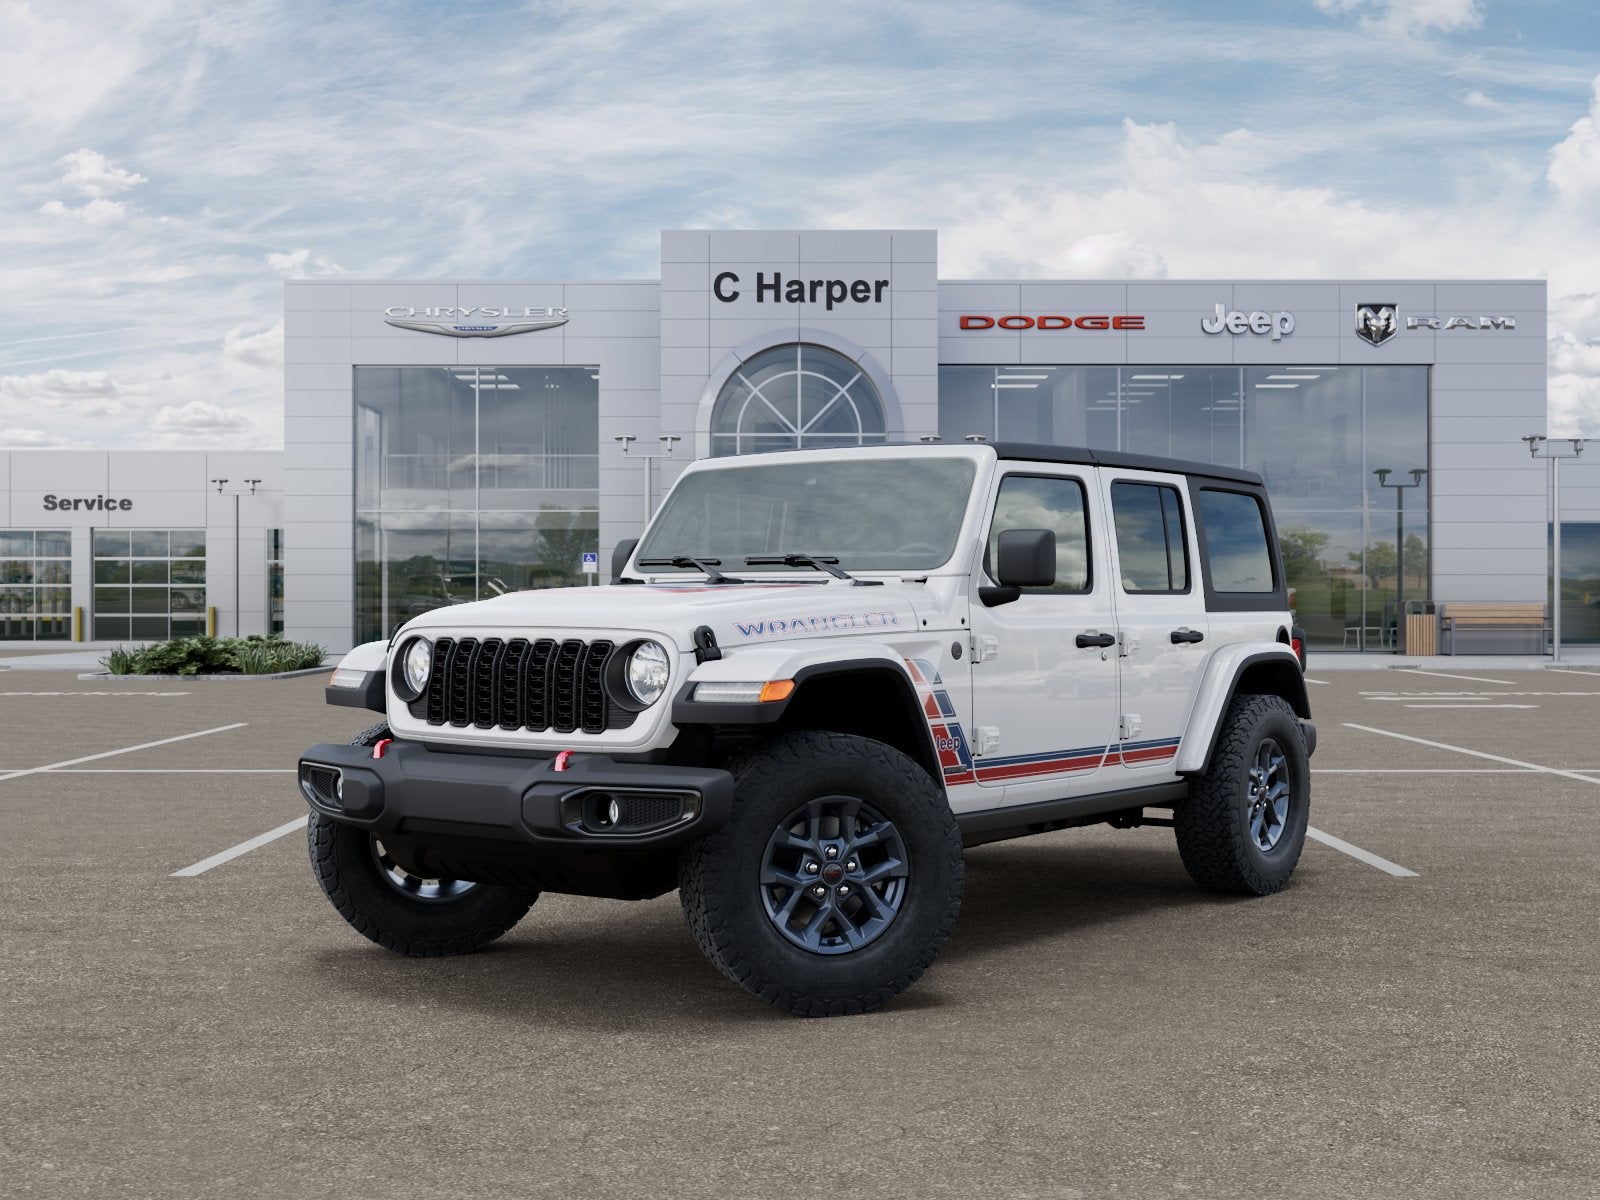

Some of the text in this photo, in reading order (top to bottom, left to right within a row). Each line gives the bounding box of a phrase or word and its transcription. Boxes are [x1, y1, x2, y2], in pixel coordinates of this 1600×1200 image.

[713, 271, 890, 311] C Harper
[384, 306, 569, 317] CHRYSLER
[959, 315, 1146, 330] DODGE
[1201, 303, 1296, 341] Jeep
[1406, 316, 1516, 330] RAM
[43, 494, 133, 511] Service
[734, 612, 899, 639] WRANGLER
